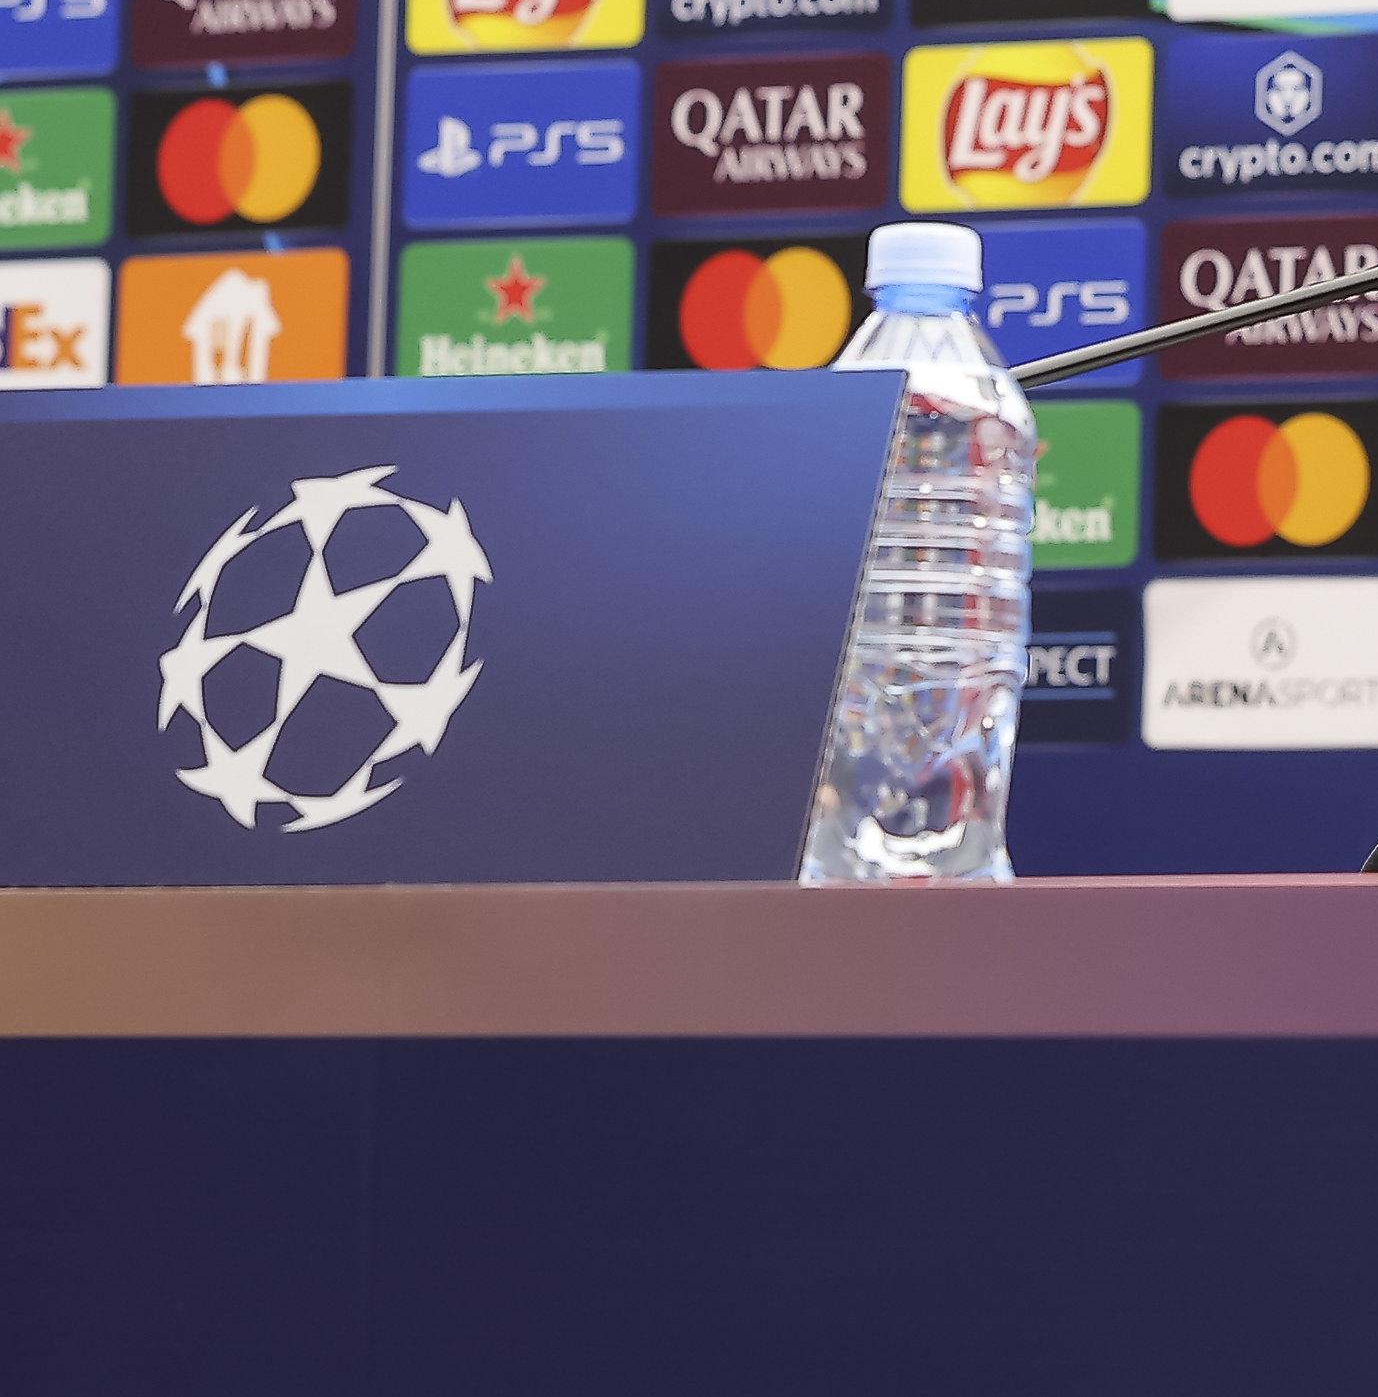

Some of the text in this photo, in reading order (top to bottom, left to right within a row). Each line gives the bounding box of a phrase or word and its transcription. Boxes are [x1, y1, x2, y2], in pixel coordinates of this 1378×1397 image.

[488, 119, 625, 168] PS5
[671, 83, 864, 157] QATAR
[950, 75, 1107, 184] Lay's
[987, 279, 1130, 328] PS5
[420, 332, 606, 375] Heineken
[1029, 645, 1117, 687] PECT
